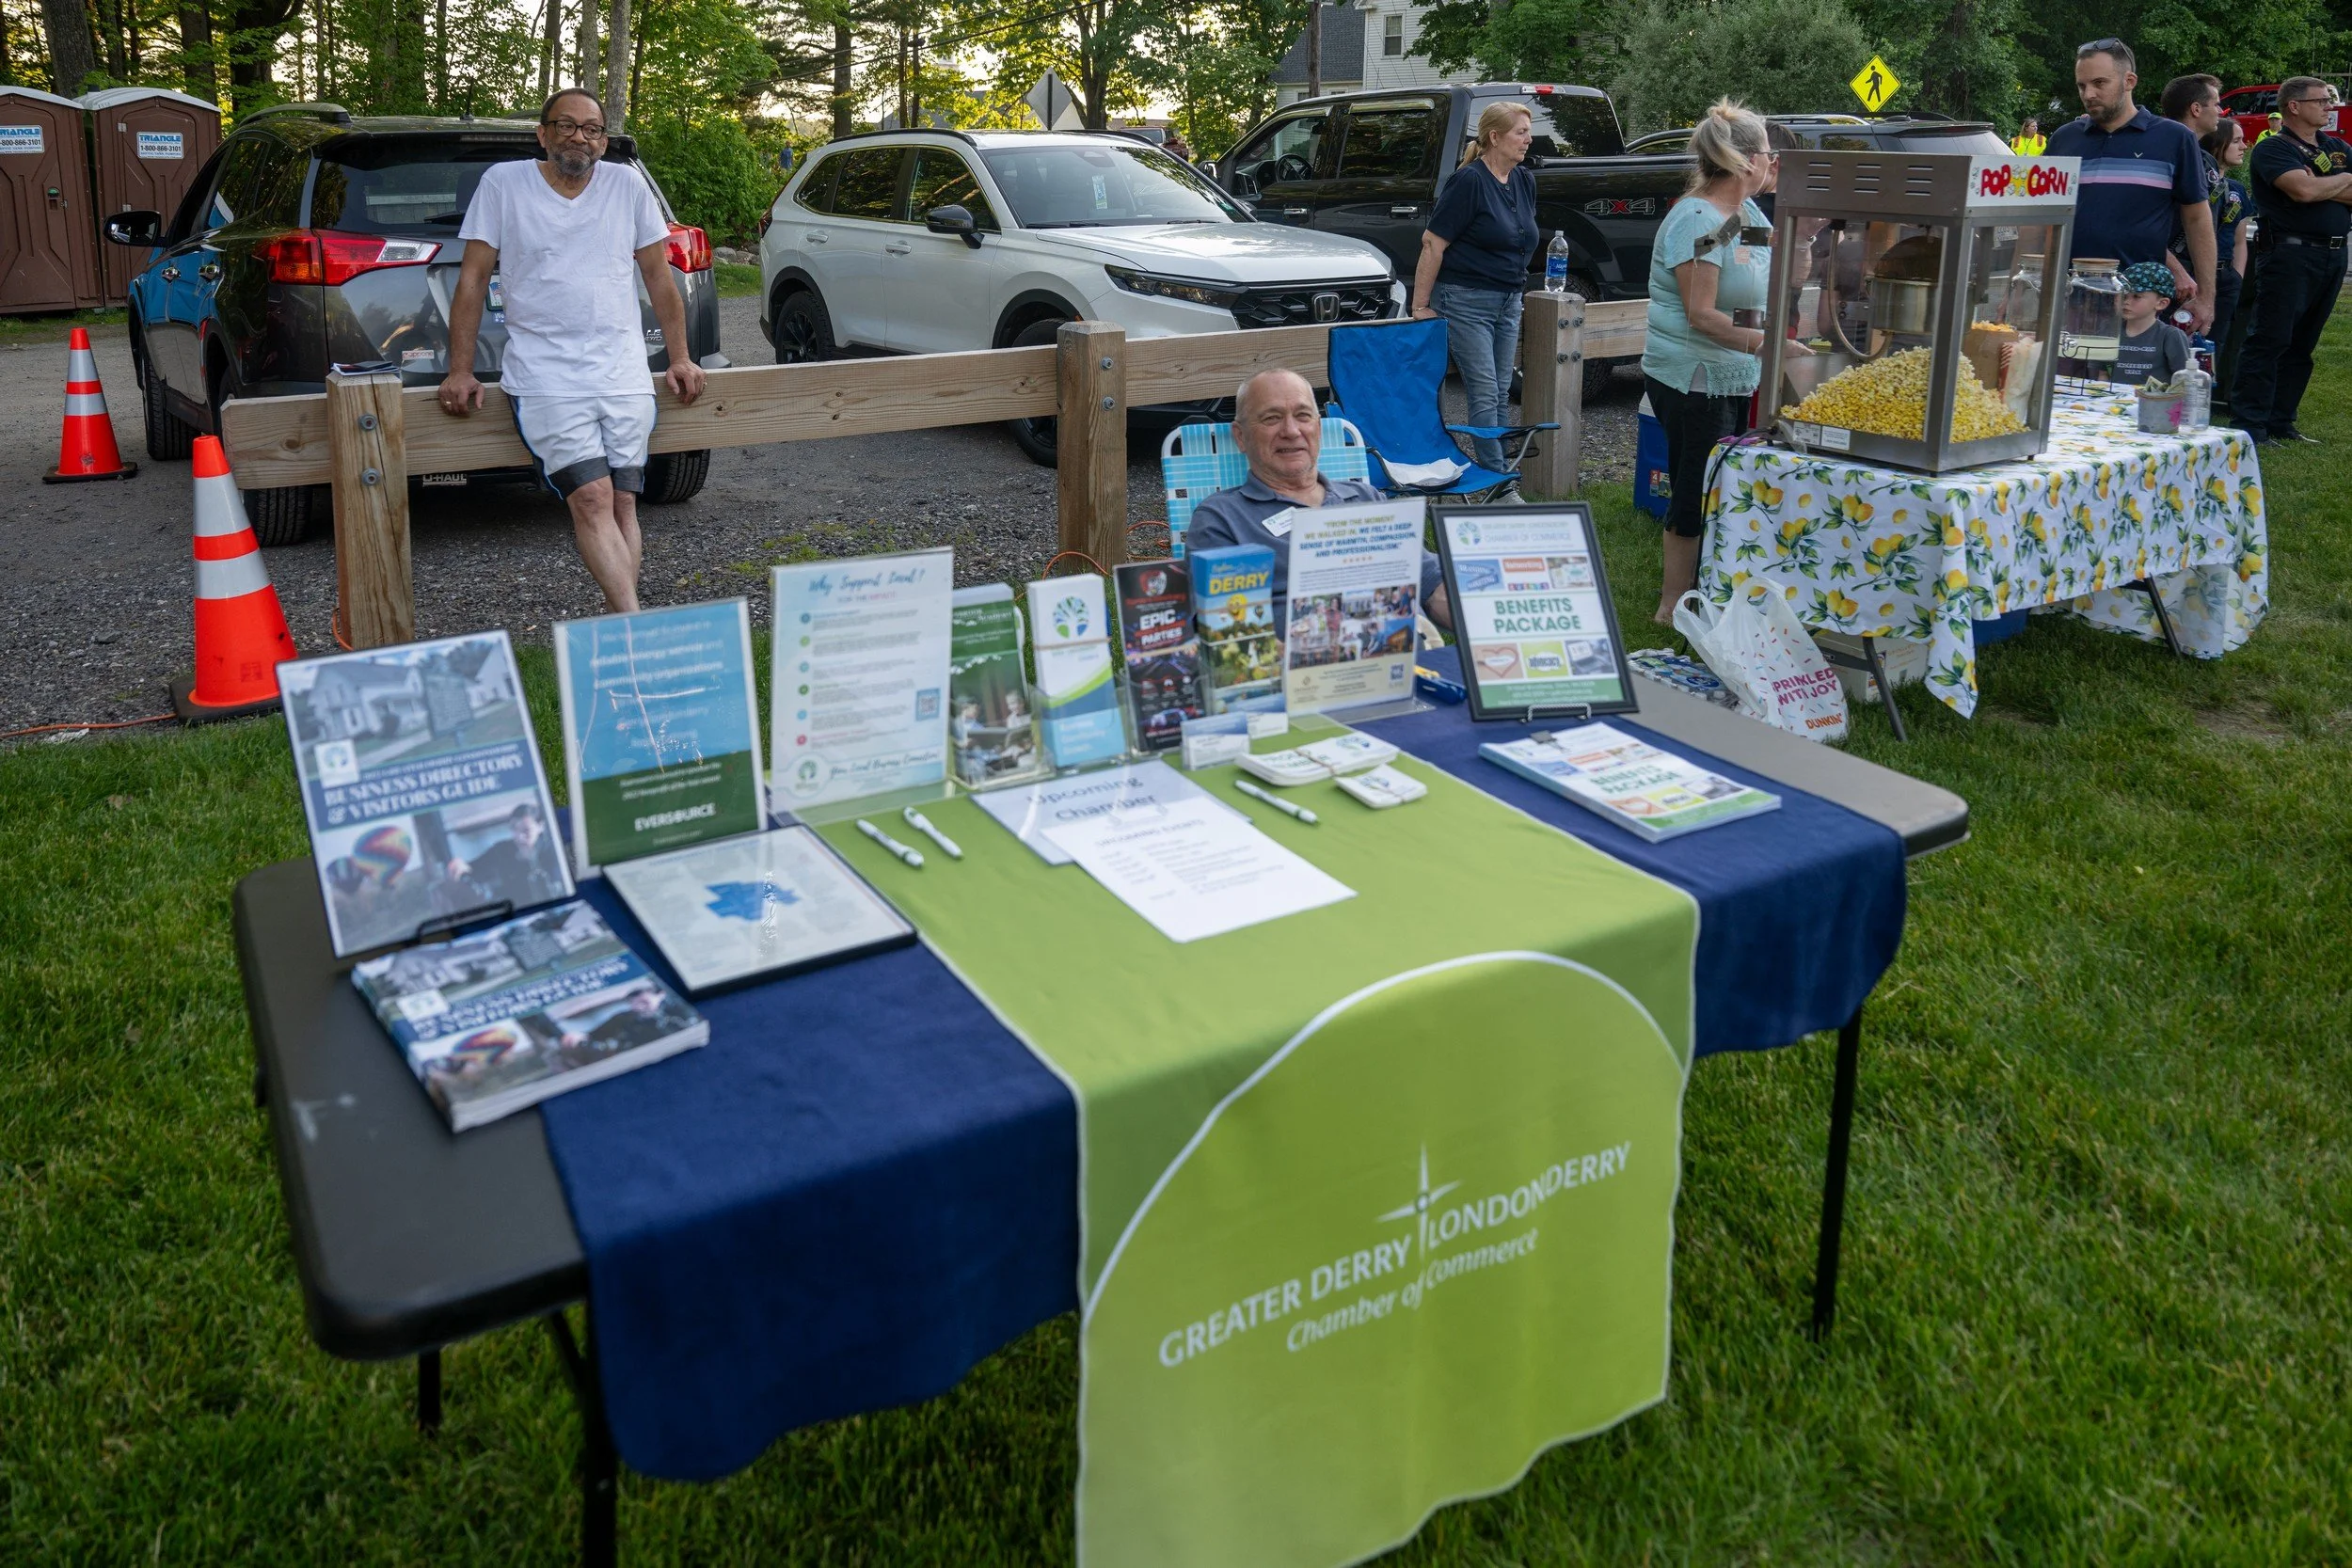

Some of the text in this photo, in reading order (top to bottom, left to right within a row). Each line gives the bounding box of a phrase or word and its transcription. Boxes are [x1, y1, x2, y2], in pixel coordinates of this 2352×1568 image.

[1980, 165, 2069, 198] POP CORN
[422, 473, 467, 483] U-HAUL
[1209, 571, 1269, 595] DERRY
[1494, 597, 1573, 615] BENEFITS
[1139, 609, 1176, 630] EPIC
[1493, 615, 1581, 633] PACKAGE
[1141, 627, 1183, 646] PARTIES
[1810, 680, 1837, 698] JOY
[1804, 713, 1843, 729] DUNKIN'
[325, 773, 418, 807] BUSINESS
[420, 753, 523, 787] DIRECTORY
[1027, 776, 1143, 804] Upcoming
[348, 786, 441, 819] VISITORS
[441, 775, 501, 800] GUIDE
[1055, 795, 1157, 821] Chamber
[1158, 1140, 1632, 1368] GREATER DERRY LONDONDERRY
[1286, 1227, 1539, 1353] Chamber of Commerce
